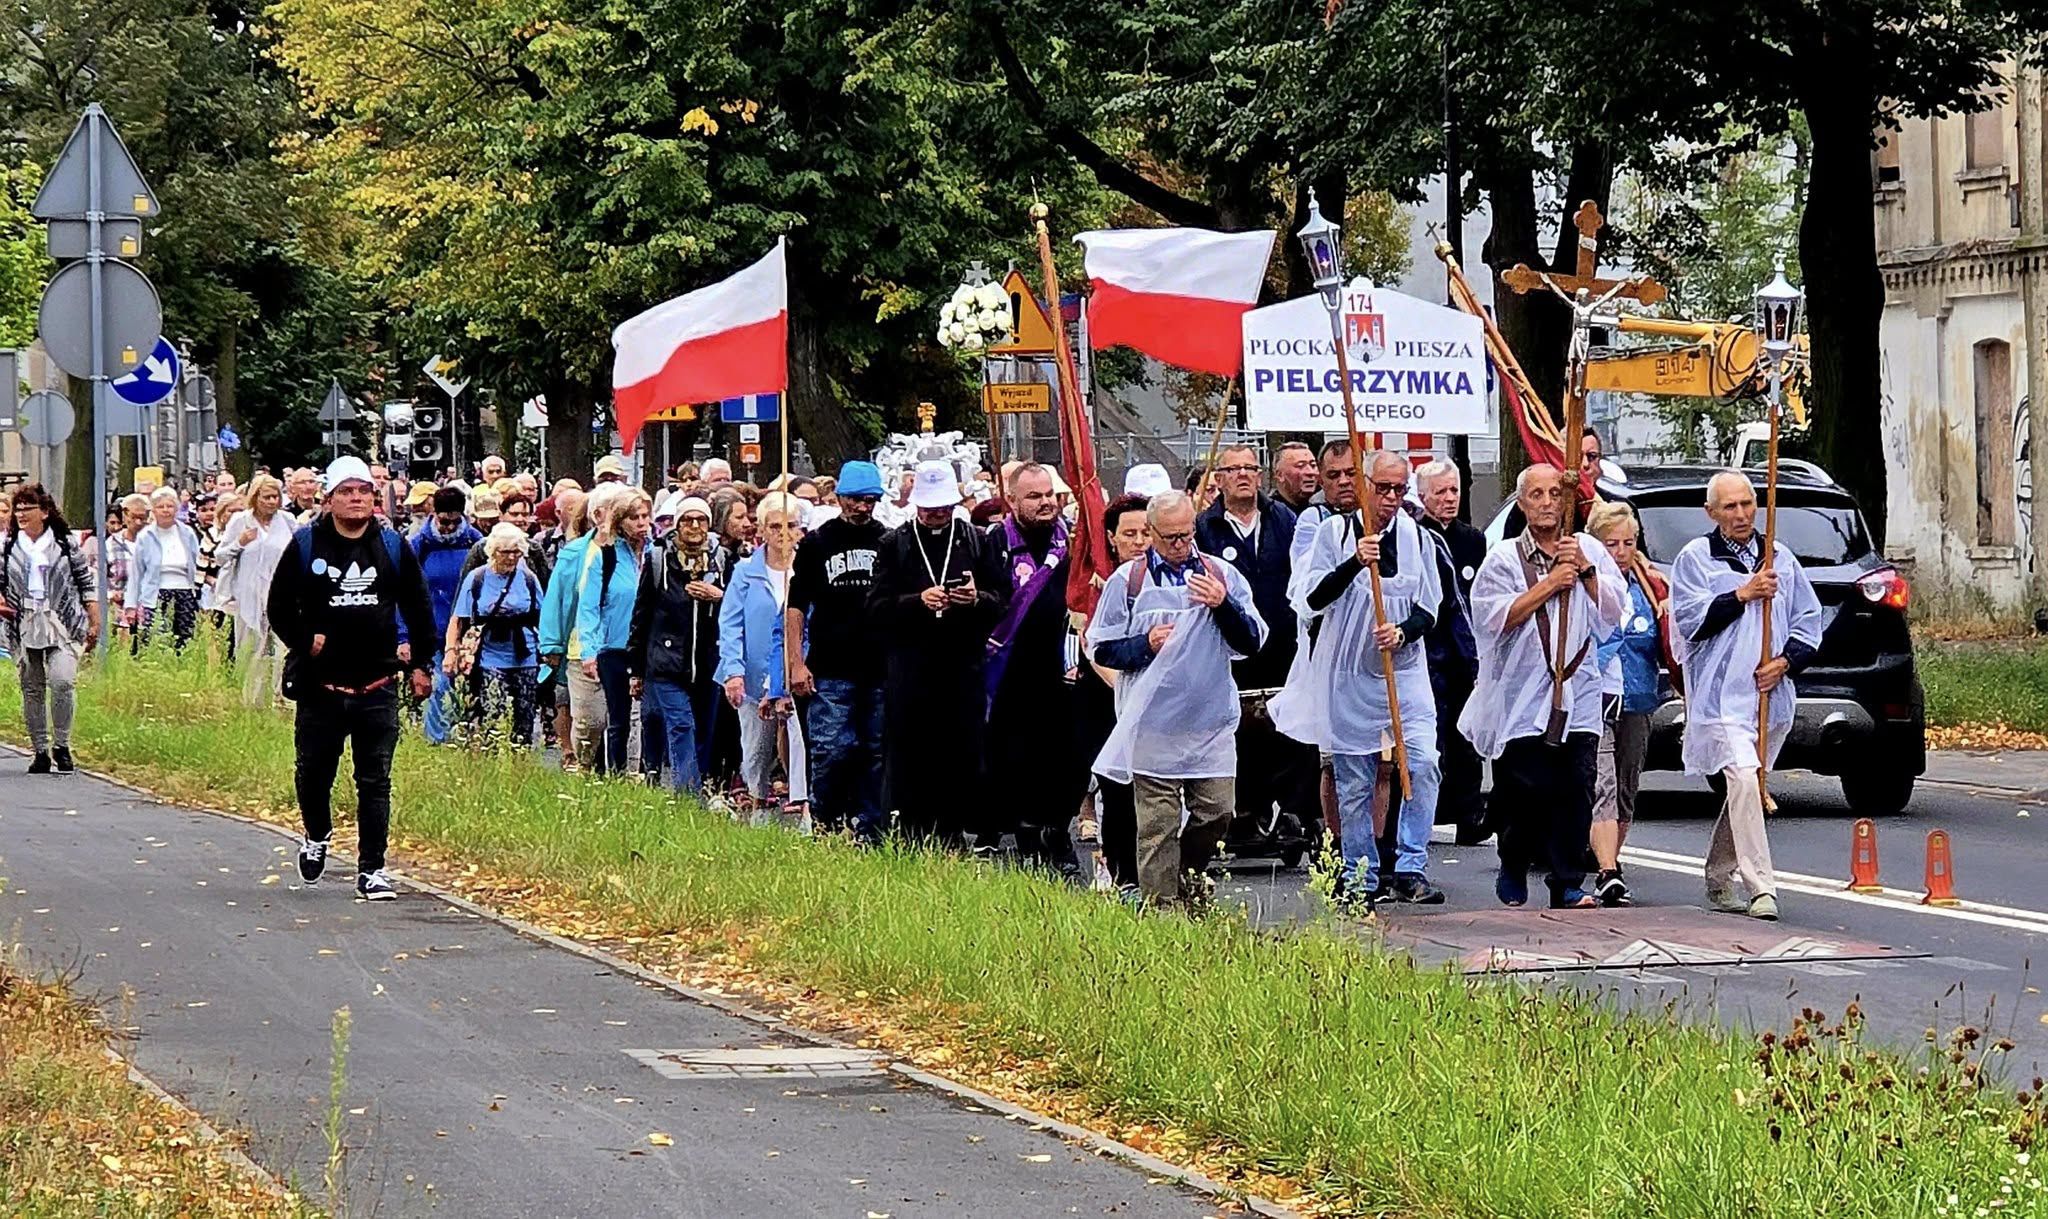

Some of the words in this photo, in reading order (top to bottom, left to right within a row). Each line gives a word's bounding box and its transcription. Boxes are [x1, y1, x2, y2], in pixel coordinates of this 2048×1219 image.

[1395, 341, 1473, 358] PIESZA
[1656, 356, 1695, 376] 914
[1254, 368, 1474, 395] PIELGRZYMKA
[1309, 403, 1334, 418] DO
[1340, 403, 1425, 422] SKĘPEGO
[825, 552, 847, 584] LOS
[328, 592, 379, 607] adidas
